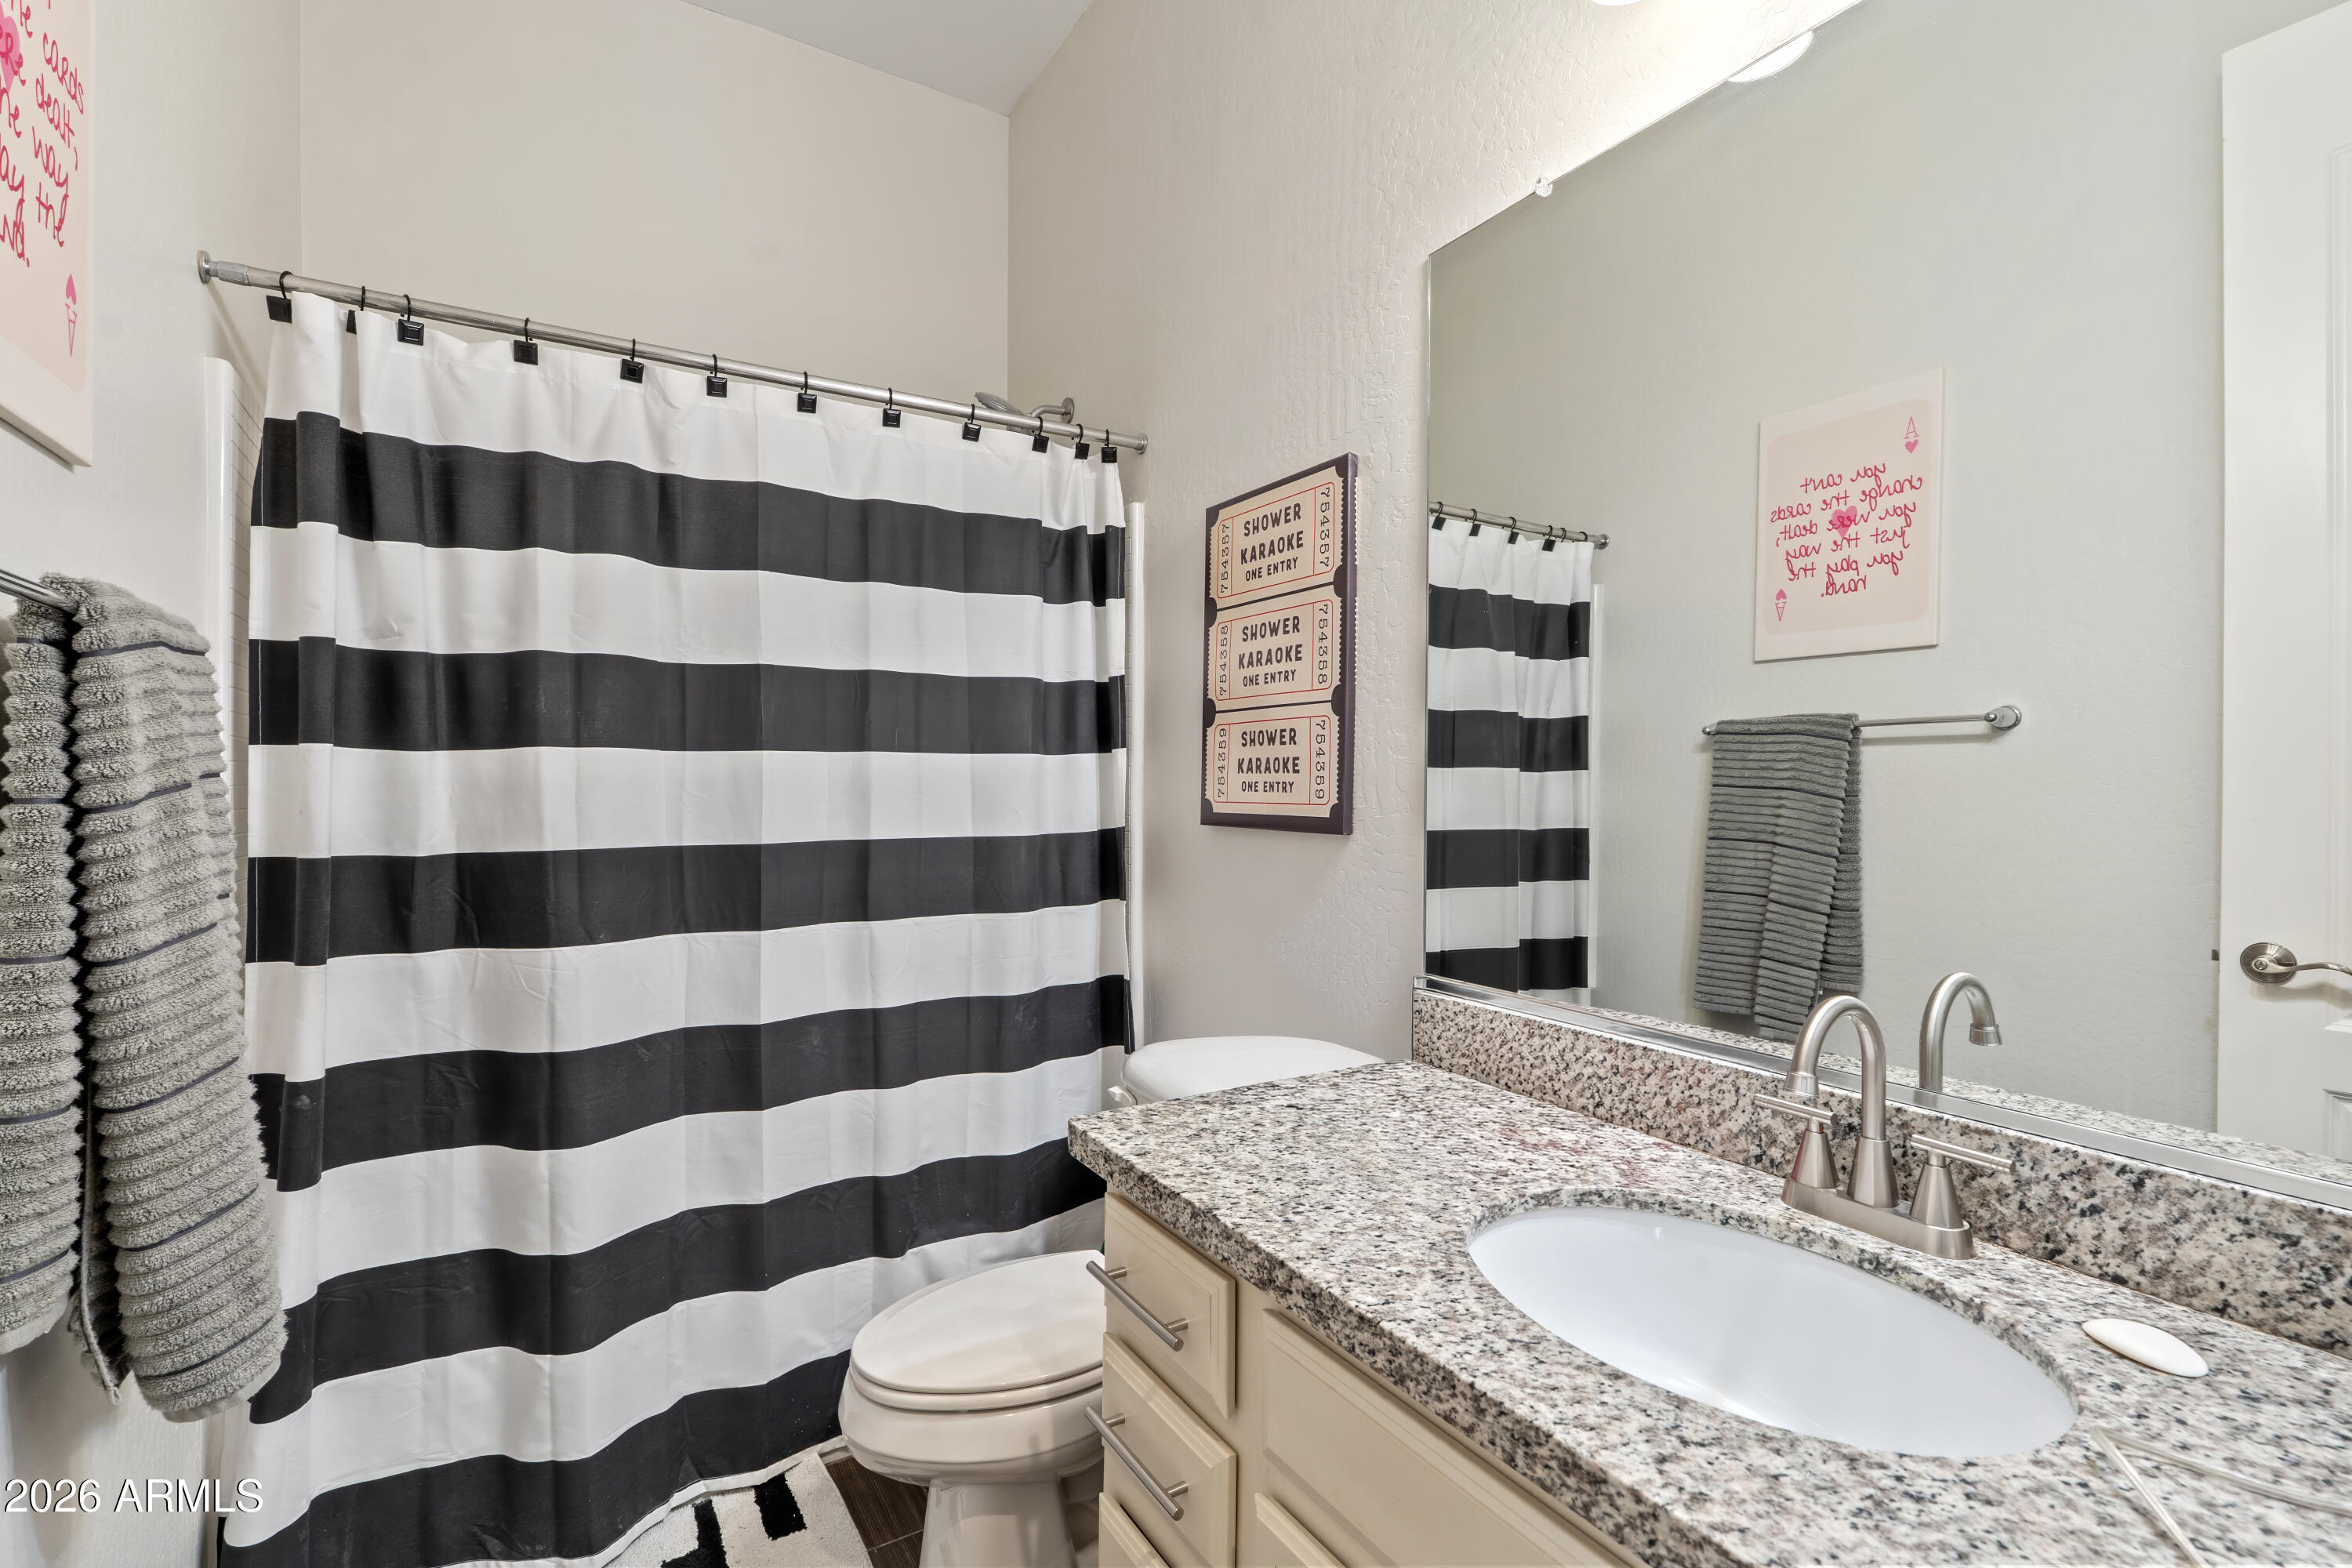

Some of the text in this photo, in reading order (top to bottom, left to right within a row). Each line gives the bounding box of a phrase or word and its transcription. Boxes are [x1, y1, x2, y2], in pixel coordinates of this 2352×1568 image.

[35, 72, 78, 172] dealt,
[0, 74, 22, 139] he
[31, 125, 69, 229] way
[35, 182, 64, 248] the
[1243, 503, 1301, 537] SHOWER
[1319, 487, 1330, 568] 754357
[1220, 524, 1229, 593] 754357
[1240, 530, 1304, 565] KARAOKE
[1245, 557, 1298, 582] ONE ENTRY
[1242, 615, 1300, 642] SHOWER
[1318, 604, 1329, 684] 754358
[1219, 625, 1229, 695] 754358
[1238, 644, 1302, 670] KARAOKE
[1243, 670, 1297, 687] ONE ENTRY
[1218, 728, 1227, 798] 754359
[1240, 728, 1297, 748] SHOWER
[1315, 720, 1326, 800] 754359
[1237, 756, 1300, 775] KARAOKE
[1241, 781, 1294, 793] ONE ENTRY
